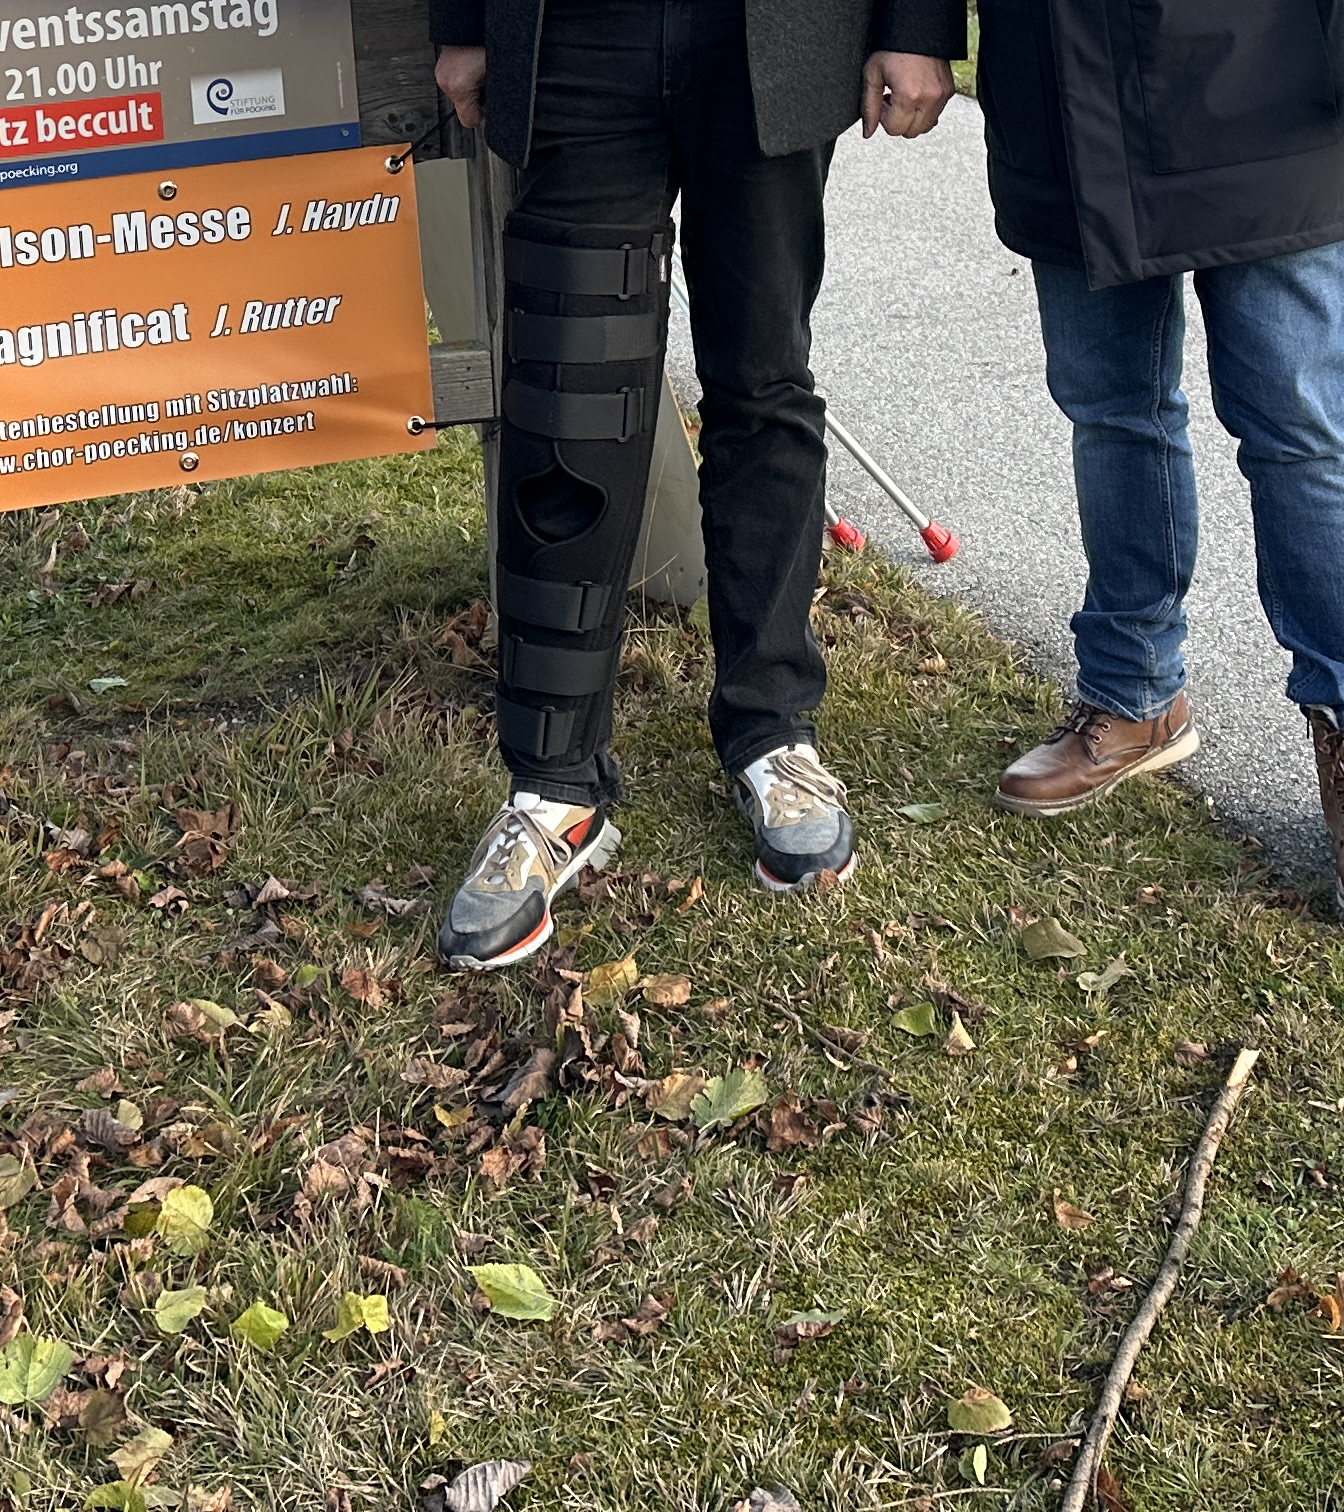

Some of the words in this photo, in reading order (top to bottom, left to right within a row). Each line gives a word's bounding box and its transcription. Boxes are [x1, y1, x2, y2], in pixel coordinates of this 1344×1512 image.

[4, 59, 95, 101] 21.00
[104, 53, 163, 90] Uhr
[37, 99, 154, 144] beccult
[230, 95, 275, 107] STIFTUNG
[272, 203, 294, 237] J.
[301, 192, 401, 234] Haydn
[209, 304, 232, 339] J.
[240, 294, 342, 335] Rutter
[165, 393, 202, 419] mit
[206, 371, 359, 414] Sitzplatzwahl:
